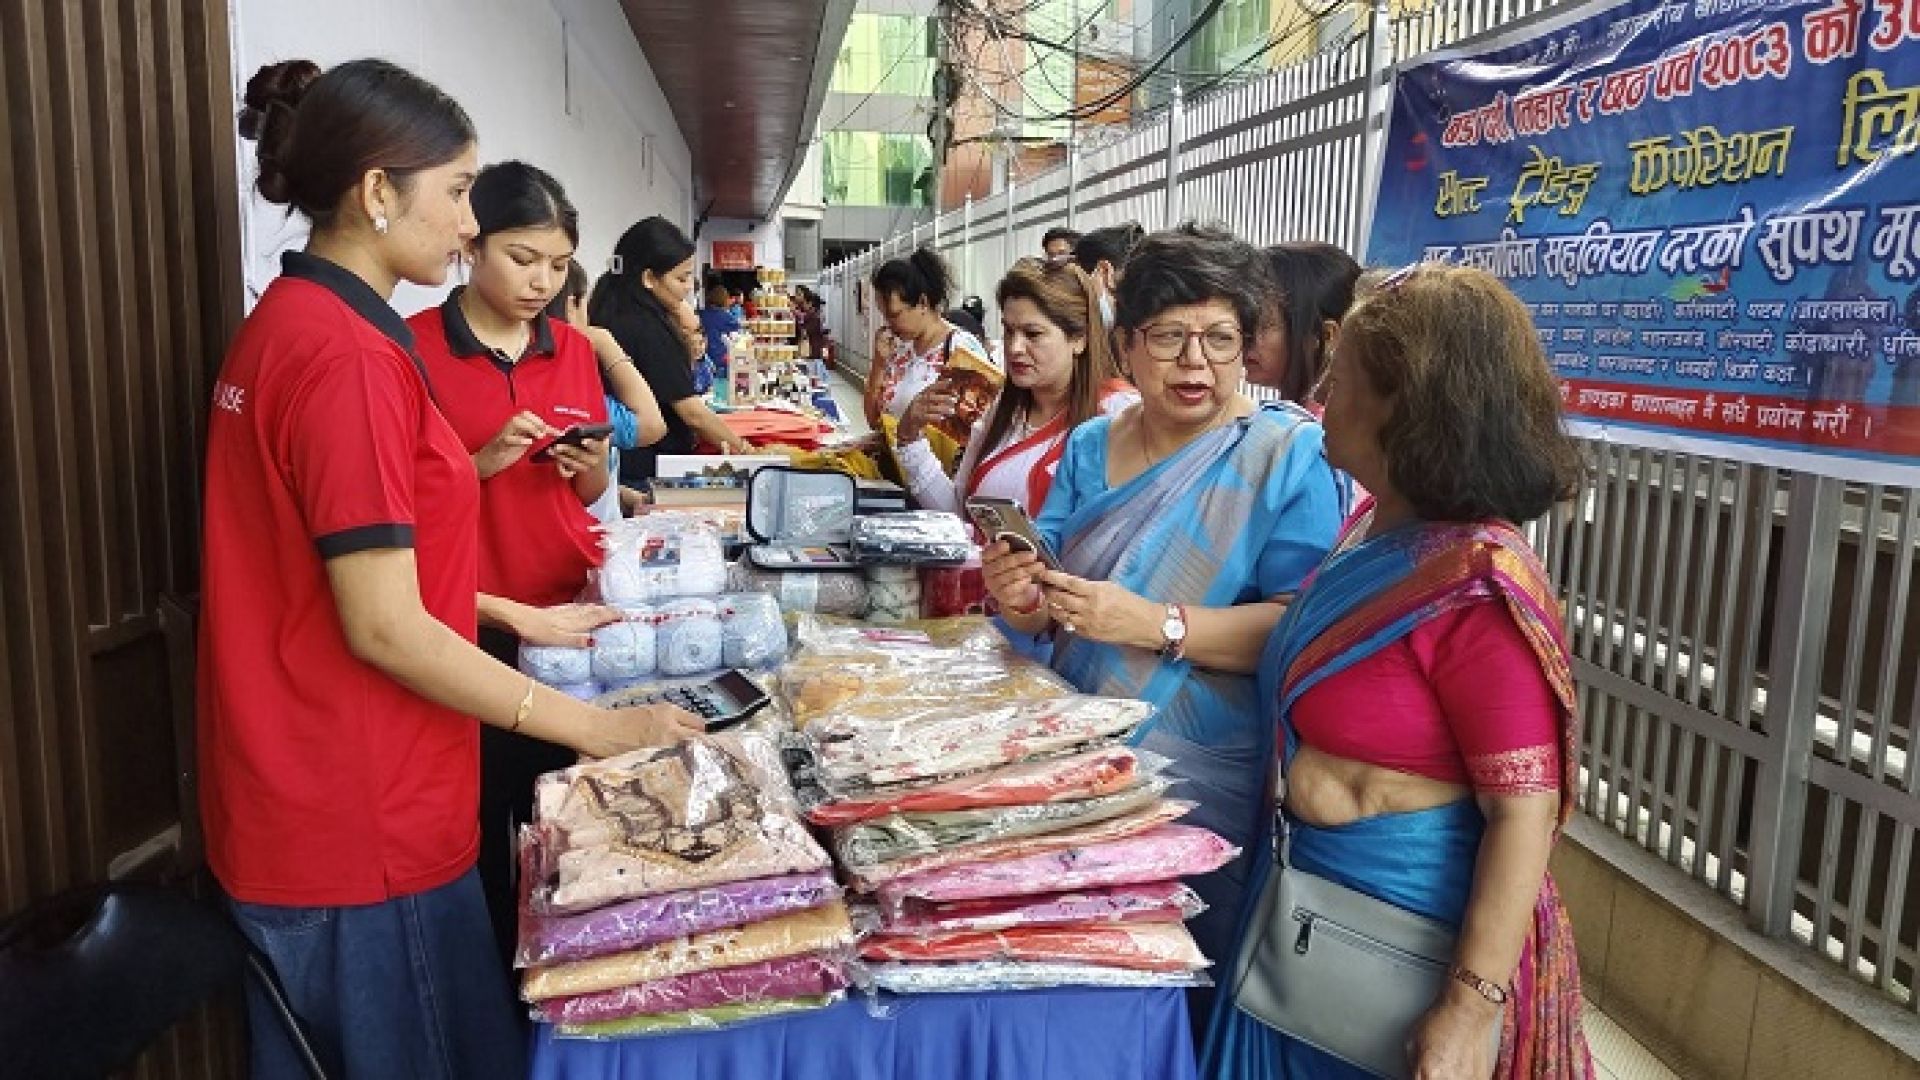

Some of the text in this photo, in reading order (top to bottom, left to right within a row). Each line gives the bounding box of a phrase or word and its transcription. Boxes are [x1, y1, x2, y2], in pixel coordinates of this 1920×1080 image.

[1577, 78, 1600, 123] र
[1699, 21, 1792, 90] २०८३
[1802, 0, 1863, 66] को
[1543, 220, 1660, 286] सहुलियत
[1659, 204, 1756, 275] दरको
[1757, 209, 1866, 282] सुपथ
